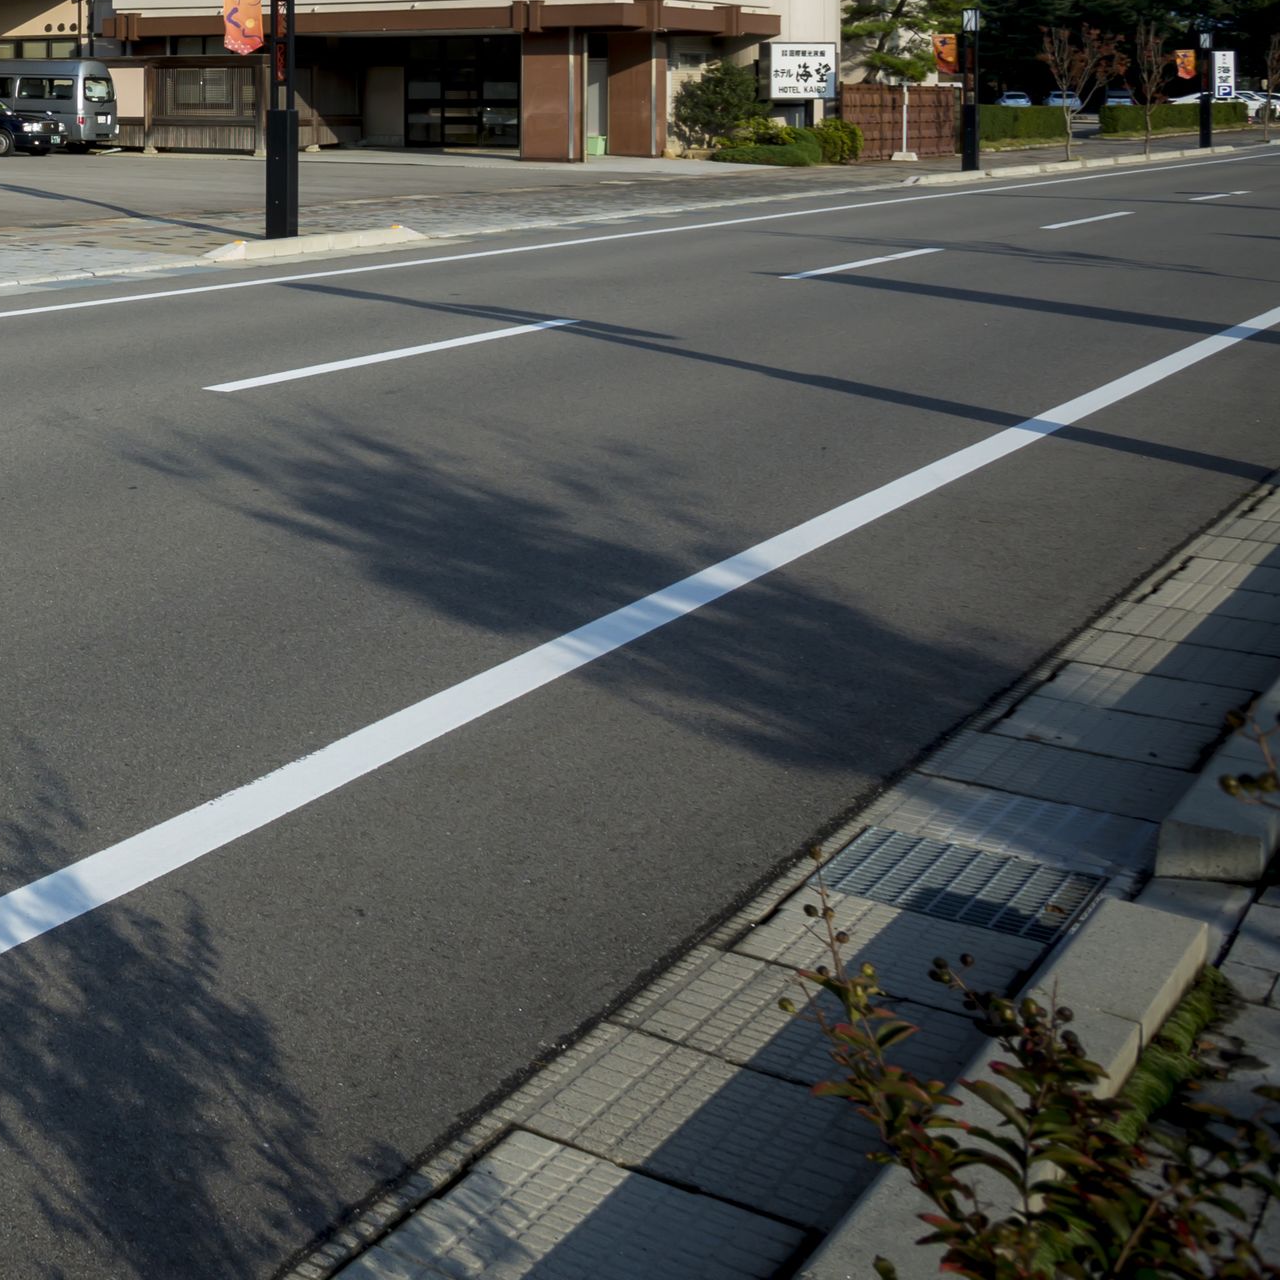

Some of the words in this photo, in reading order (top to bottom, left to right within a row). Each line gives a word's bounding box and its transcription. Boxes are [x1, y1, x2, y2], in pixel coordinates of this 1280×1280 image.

[773, 62, 832, 83] ホテル海望
[778, 86, 801, 94] HOTEL
[1220, 86, 1230, 96] P
